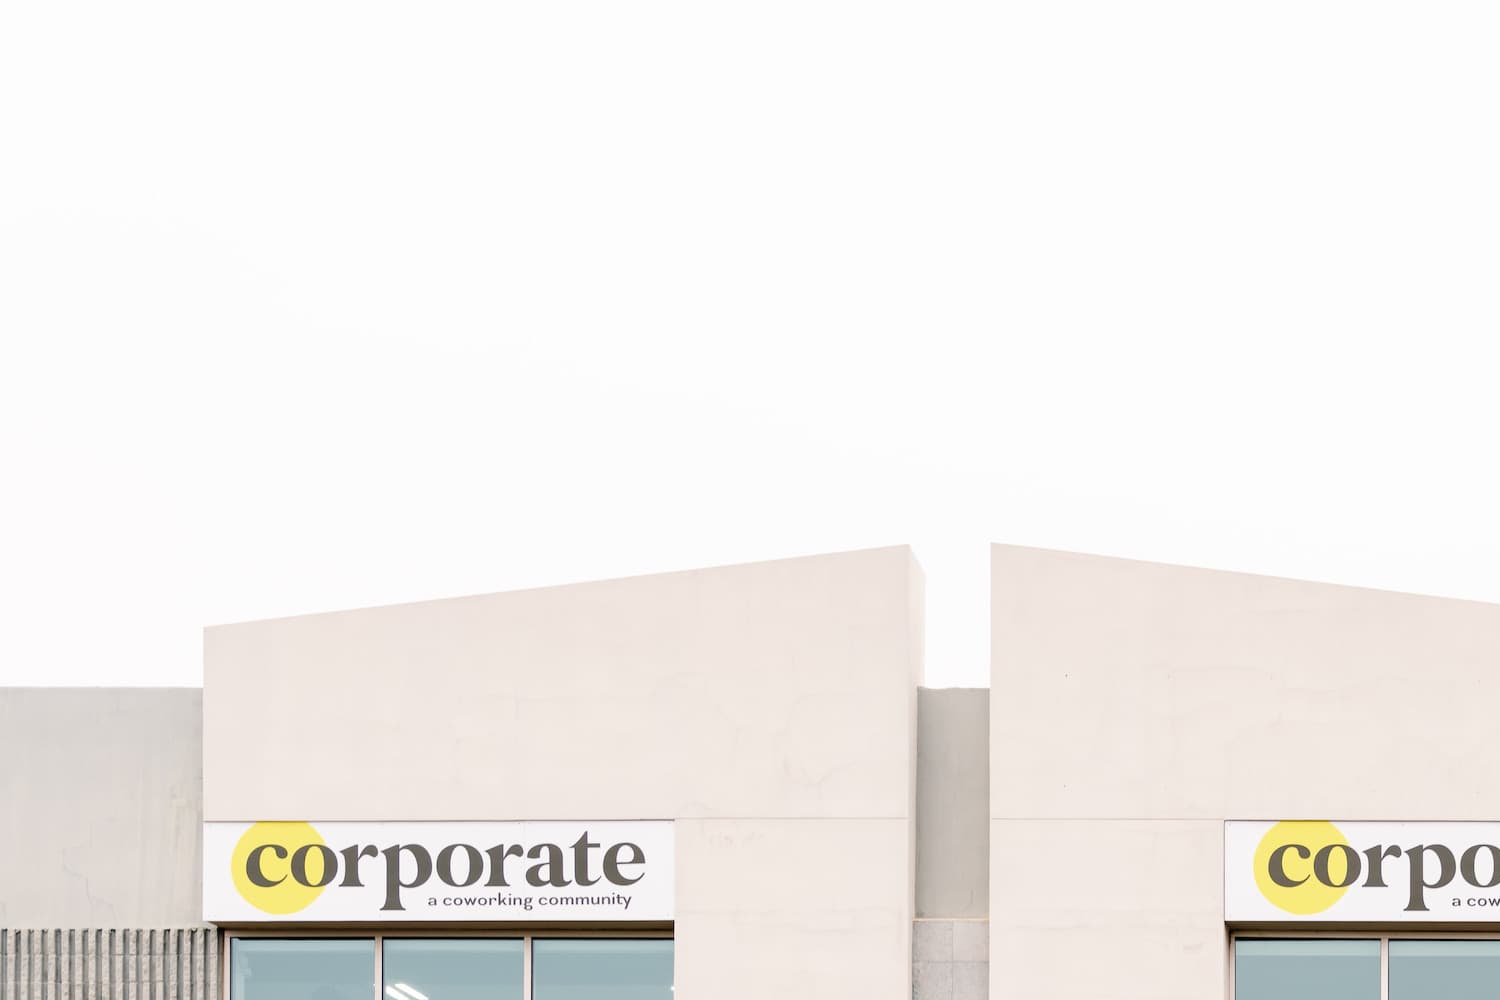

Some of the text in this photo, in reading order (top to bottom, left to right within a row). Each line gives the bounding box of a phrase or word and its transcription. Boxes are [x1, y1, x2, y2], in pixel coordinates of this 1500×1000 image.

[246, 831, 645, 911] corporate
[427, 892, 633, 911] a coworking community
[1452, 898, 1462, 907] a
